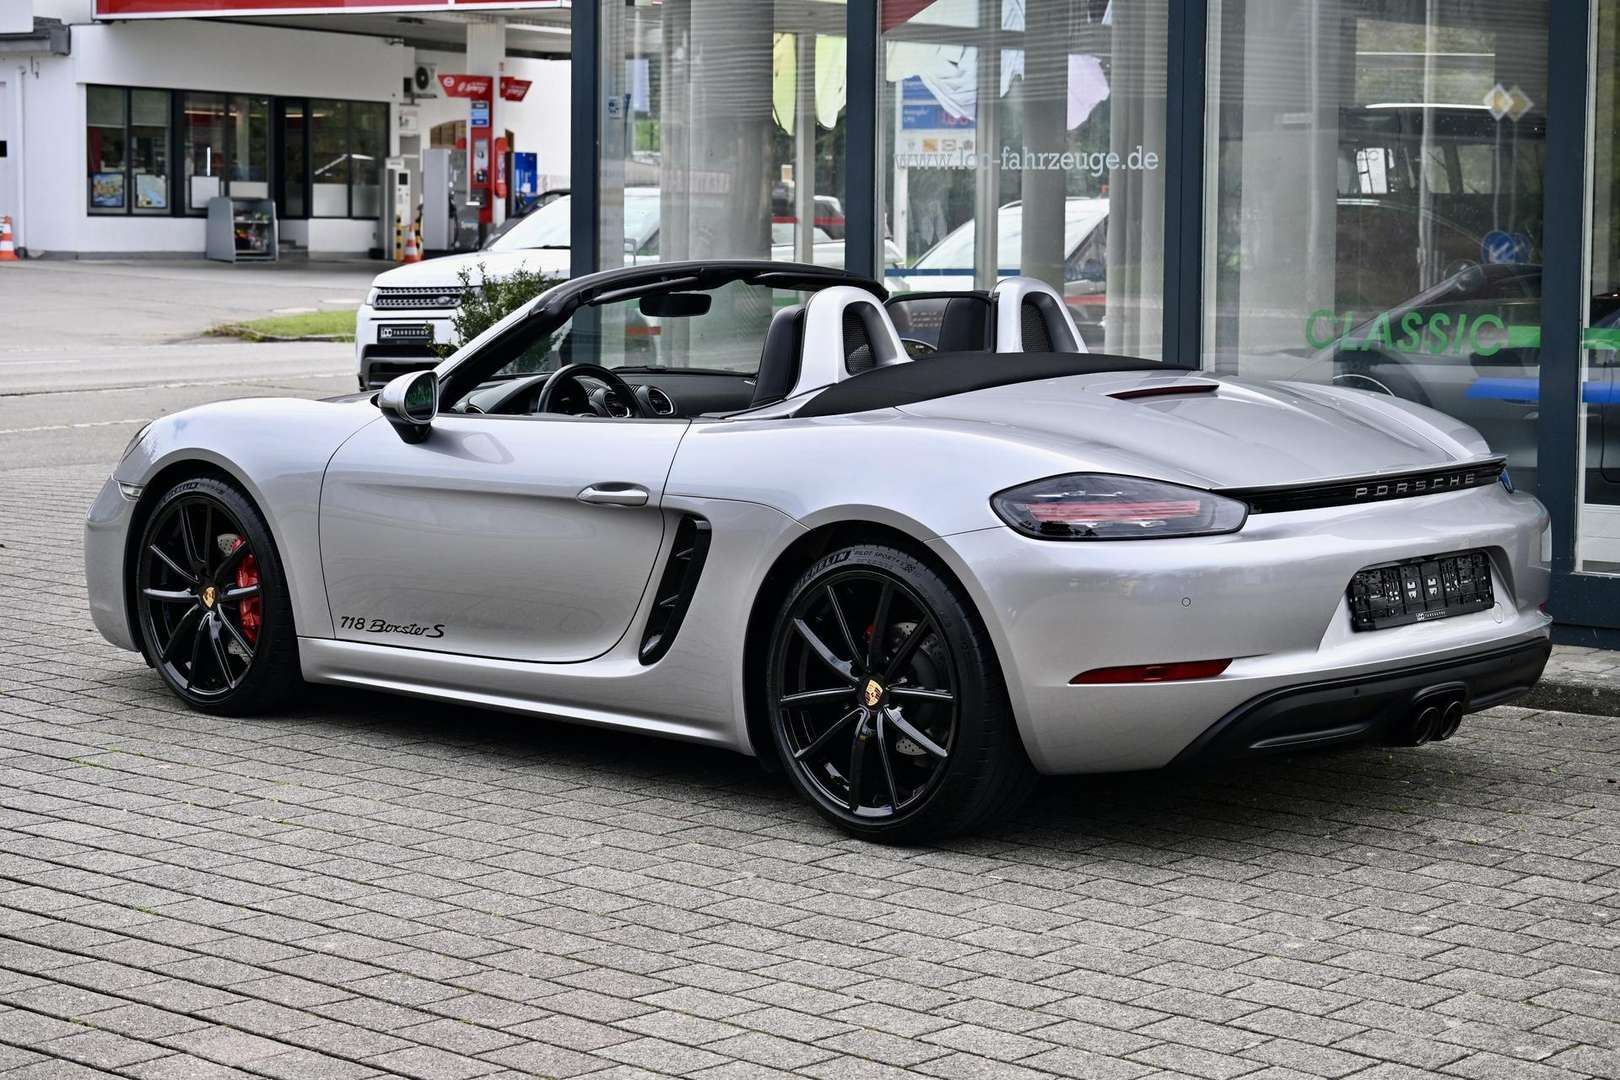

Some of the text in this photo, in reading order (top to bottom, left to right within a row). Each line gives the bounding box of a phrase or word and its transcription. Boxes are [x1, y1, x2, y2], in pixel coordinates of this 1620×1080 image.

[1306, 308, 1505, 357] CLASSIC
[1354, 473, 1475, 499] PORSCHE
[341, 616, 446, 639] 718 Boxster S
